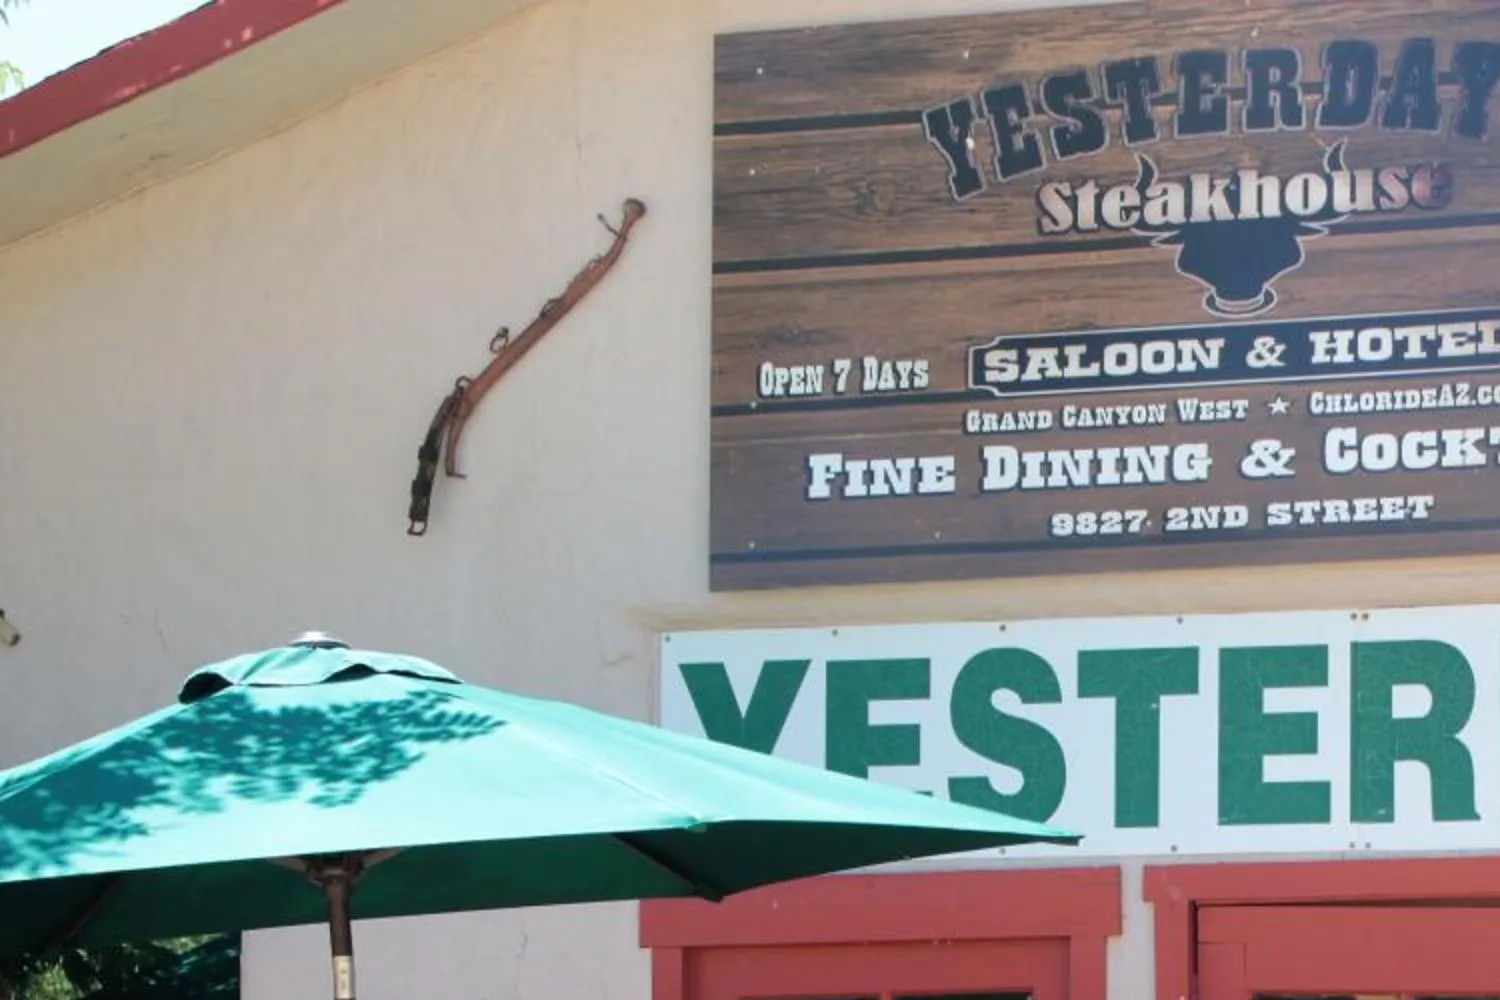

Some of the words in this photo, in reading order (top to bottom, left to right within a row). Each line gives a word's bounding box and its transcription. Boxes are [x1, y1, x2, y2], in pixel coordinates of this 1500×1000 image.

[1037, 161, 1454, 235] Steakhouse
[833, 359, 850, 394] 7
[984, 337, 1225, 385] SALOON
[1245, 335, 1287, 369] &
[1240, 437, 1297, 480] &
[1050, 509, 1146, 538] 9827
[1164, 502, 1249, 534] 2ND
[1267, 494, 1435, 526] STREET
